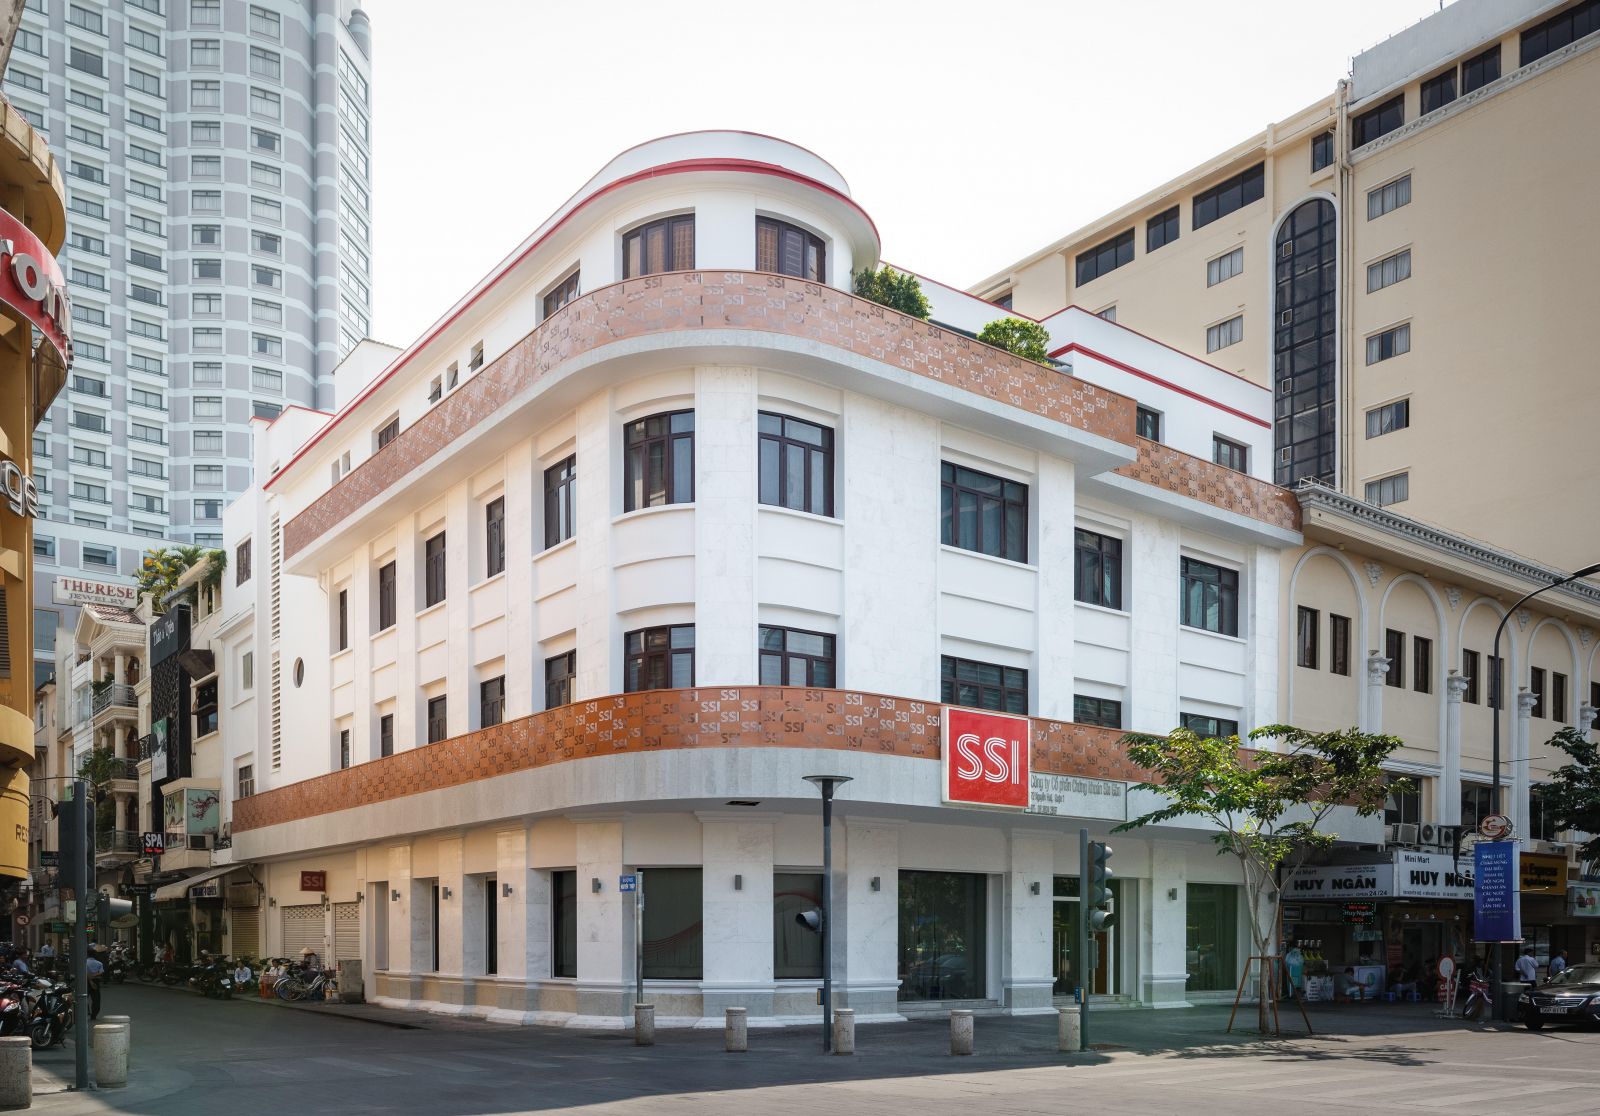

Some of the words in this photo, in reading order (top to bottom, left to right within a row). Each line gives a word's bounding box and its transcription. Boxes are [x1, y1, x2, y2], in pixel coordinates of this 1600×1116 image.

[644, 278, 662, 290] SSI
[724, 273, 744, 284] SSI
[766, 277, 784, 289] SSI
[805, 284, 821, 297] SSI
[928, 346, 942, 359] SSI
[900, 356, 914, 368] SSI
[928, 366, 942, 378] SSI
[1009, 376, 1022, 388] SSI
[1072, 389, 1083, 400] SSI
[1083, 384, 1094, 396] SSI
[1009, 394, 1022, 406] SSI
[1096, 398, 1108, 409] SSI
[1083, 402, 1094, 414] SSI
[0, 460, 38, 518] ge
[60, 578, 135, 600] THERESE
[69, 593, 126, 605] JEWELRY
[721, 689, 740, 700] SSI
[846, 694, 862, 706] SSI
[586, 702, 598, 713] SSI
[701, 702, 720, 712] SSI
[742, 700, 761, 711] SSI
[880, 698, 895, 710] SSI
[911, 702, 924, 714] SSI
[599, 710, 612, 721] SSI
[721, 712, 740, 722] SSI
[846, 715, 862, 726] SSI
[896, 712, 909, 722] SSI
[927, 715, 940, 726] SSI
[701, 722, 720, 732] SSI
[784, 722, 804, 732] SSI
[880, 720, 894, 730] SSI
[910, 723, 924, 734] SSI
[599, 730, 612, 741] SSI
[957, 734, 1019, 785] SSI
[1031, 774, 1043, 791] Công
[1045, 776, 1050, 792] ty
[145, 833, 163, 848] SPA
[1417, 856, 1430, 864] Mart
[303, 876, 324, 886] SSI
[1294, 878, 1325, 890] HUY
[1332, 874, 1376, 889] NGÂN
[1410, 870, 1439, 886] HUY
